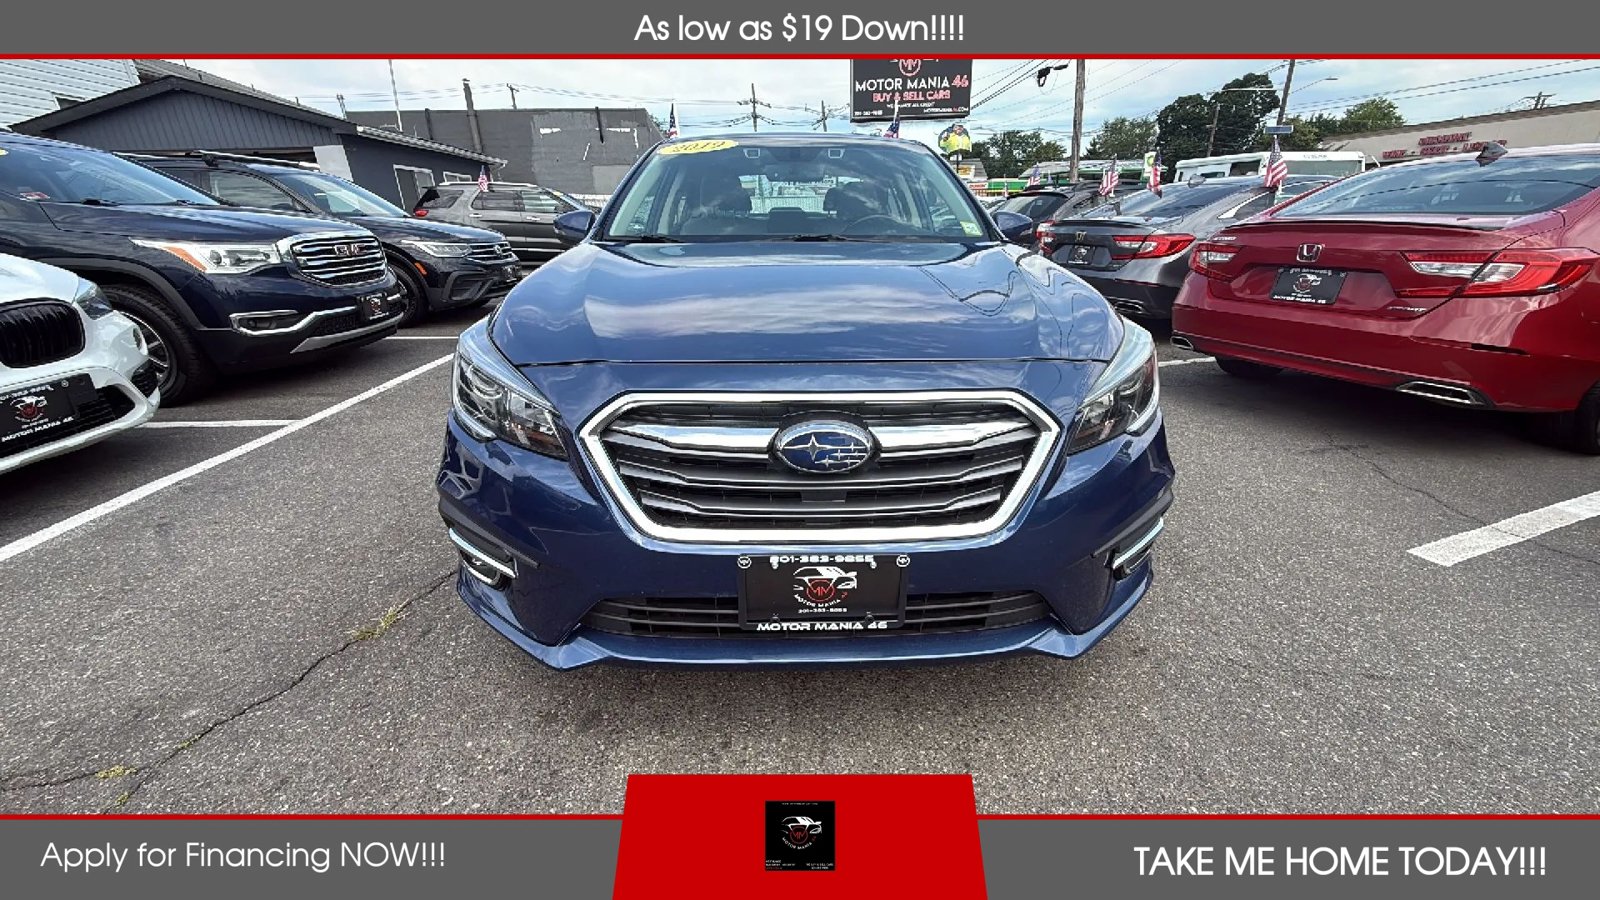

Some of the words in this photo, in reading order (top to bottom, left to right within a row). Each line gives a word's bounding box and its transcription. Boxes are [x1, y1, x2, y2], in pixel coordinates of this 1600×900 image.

[855, 77, 902, 92] MOTOR
[906, 76, 950, 90] MANIA
[951, 74, 969, 88] 46
[872, 91, 892, 103] BUY
[903, 91, 924, 101] SELL
[926, 89, 951, 100] CARS
[756, 621, 811, 631] MOTOR
[814, 620, 864, 631] MANIA
[867, 621, 888, 630] 46
